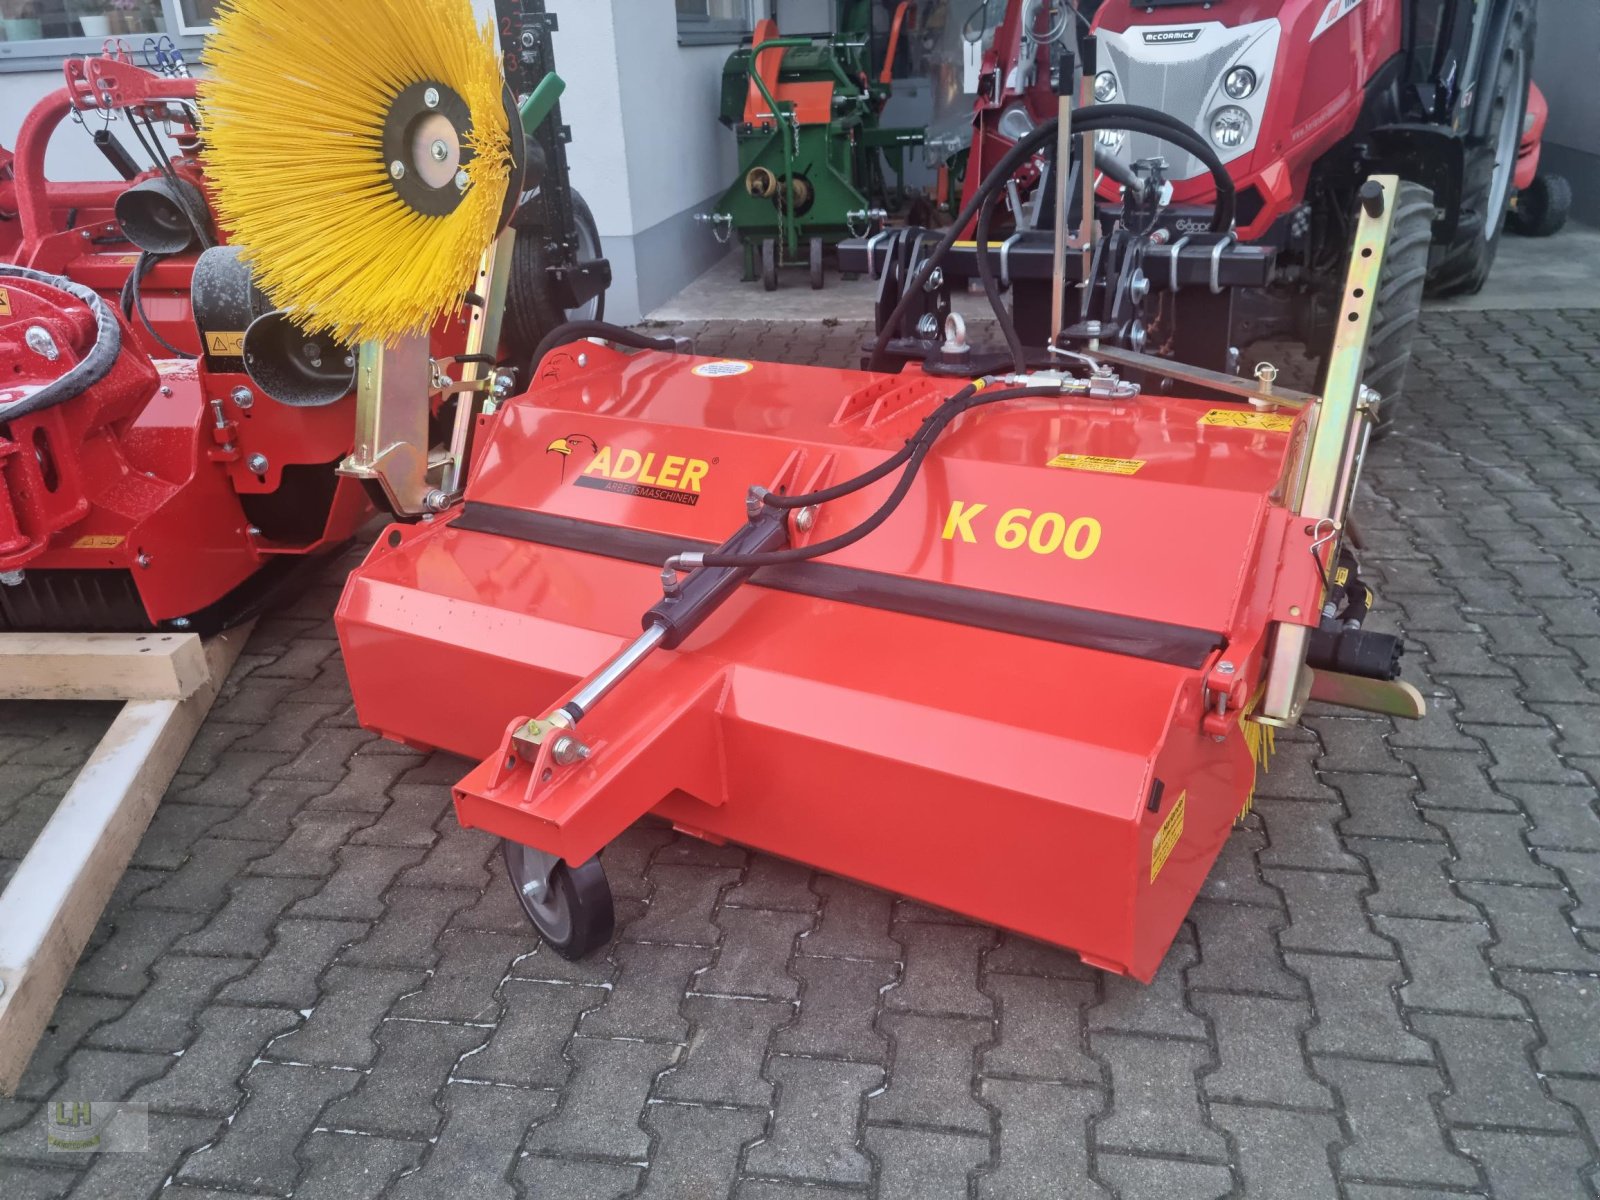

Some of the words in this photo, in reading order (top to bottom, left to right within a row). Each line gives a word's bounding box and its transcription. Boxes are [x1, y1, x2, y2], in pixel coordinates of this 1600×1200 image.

[502, 17, 512, 36] 2
[583, 446, 709, 492] ADLER
[605, 481, 698, 505] ARBEITSMASCHINEN
[942, 501, 988, 544] K
[994, 508, 1102, 560] 600
